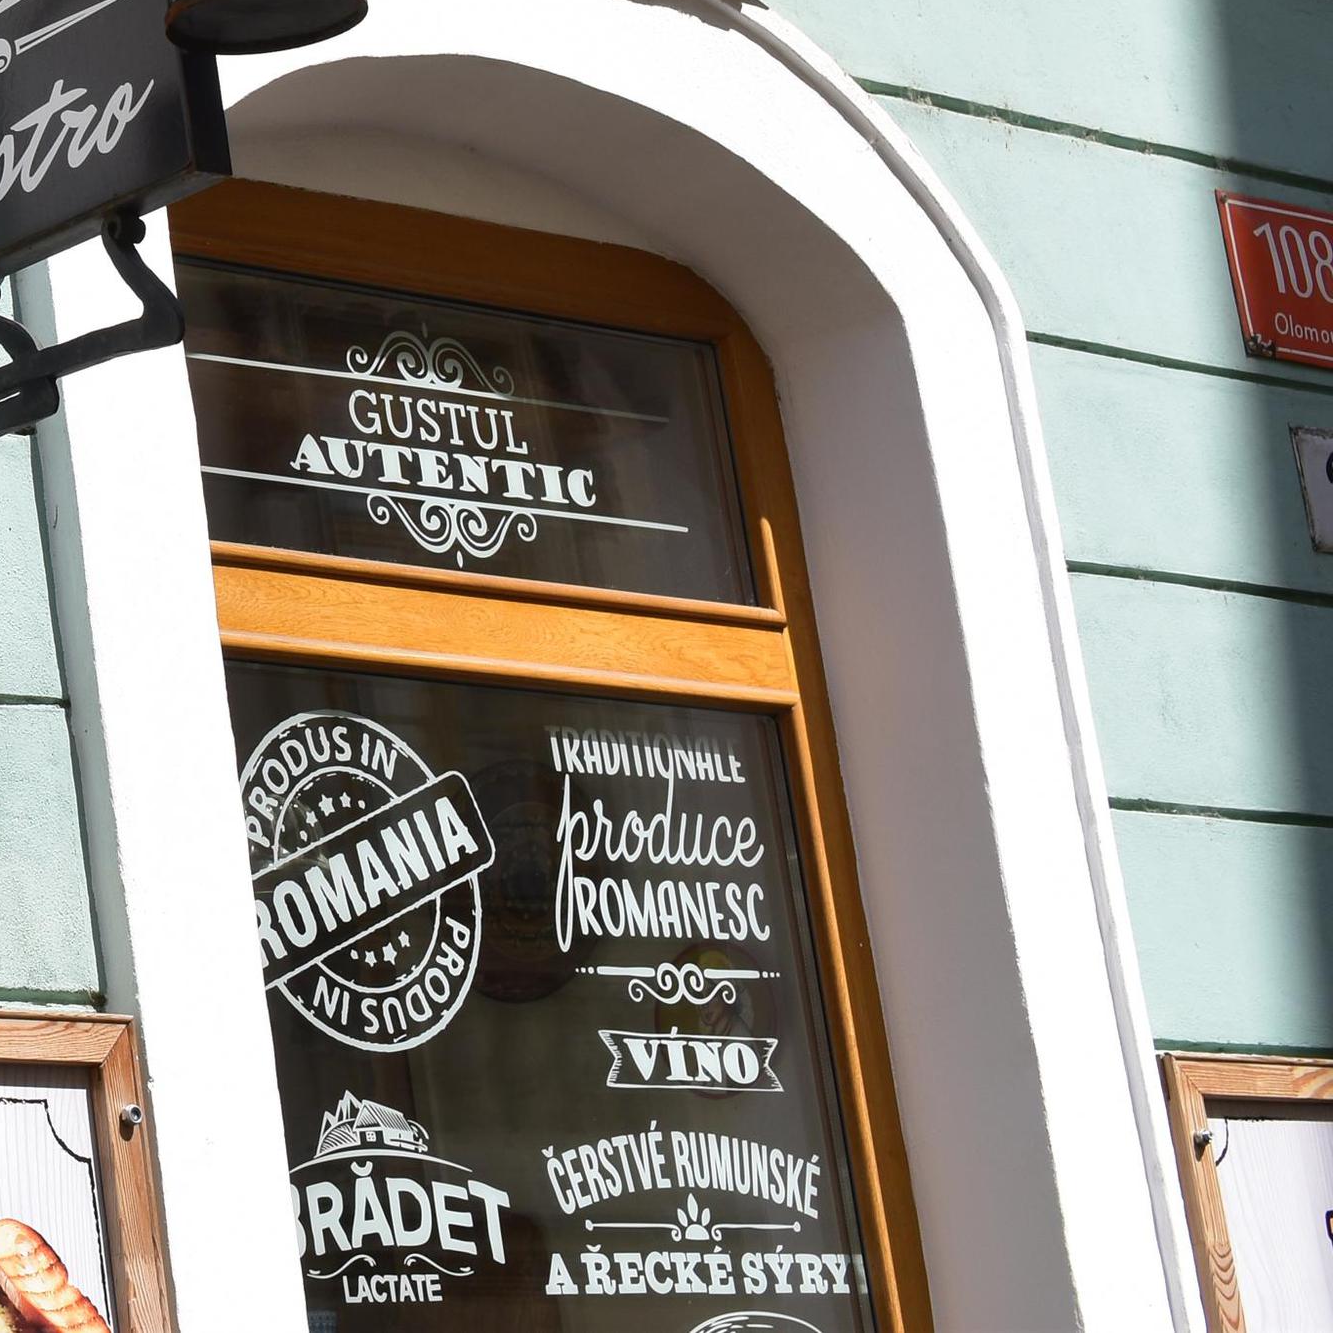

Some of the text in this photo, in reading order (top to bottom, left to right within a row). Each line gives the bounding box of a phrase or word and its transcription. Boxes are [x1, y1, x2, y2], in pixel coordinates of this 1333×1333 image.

[1253, 222, 1333, 304] 108
[1275, 312, 1333, 344] Olomo
[348, 387, 529, 456] GUSTUL
[289, 432, 597, 508] AUTENTIC
[245, 726, 398, 849] PRODUS IN
[255, 796, 479, 967] ROMANIA
[555, 773, 765, 953] produce
[573, 876, 771, 942] ROMANESC
[312, 916, 471, 1035] PRODUS IN
[623, 1025, 761, 1085] VÍNO
[541, 1119, 821, 1220] ČERSTVÉ RUMUNSKÉ
[342, 1273, 443, 1304] LACTATE
[545, 1243, 852, 1296] A ŘECKÉ SÝRY
